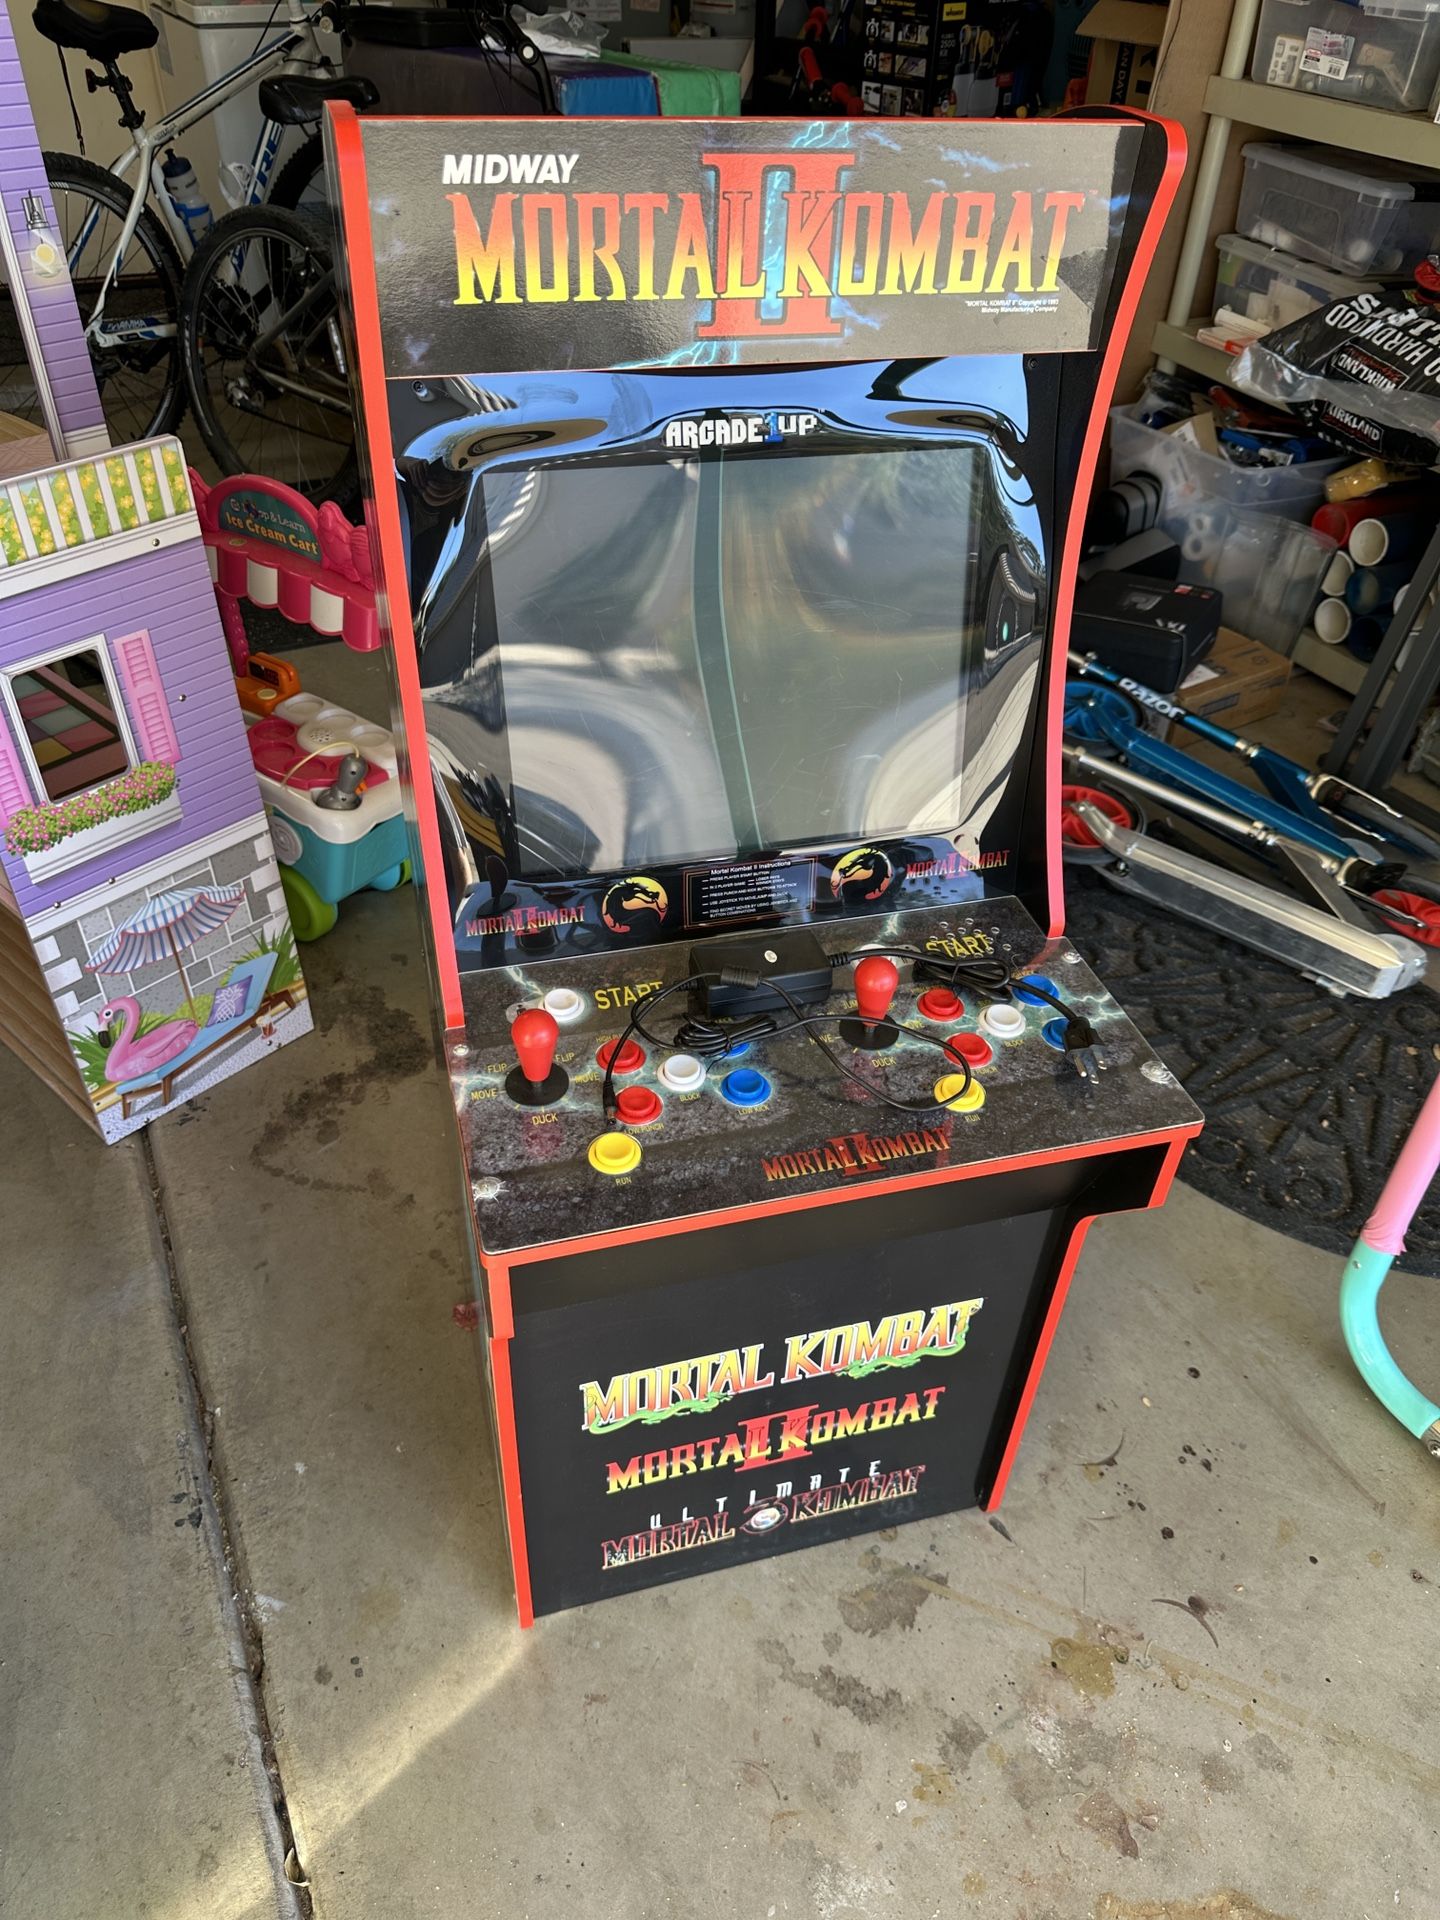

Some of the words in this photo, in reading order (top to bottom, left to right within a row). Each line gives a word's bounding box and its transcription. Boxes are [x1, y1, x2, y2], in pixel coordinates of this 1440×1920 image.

[442, 153, 579, 185] MIDWAY
[445, 190, 767, 305] MORTAL
[777, 190, 1086, 298] KOMBAT
[1327, 403, 1381, 441] KIRKLAND
[277, 512, 306, 534] Learn
[225, 511, 244, 529] Ice
[245, 518, 287, 544] Cream
[288, 533, 319, 556] Cart
[710, 867, 729, 876] Mortal
[730, 864, 752, 874] Kombat
[758, 860, 792, 870] Instructions
[906, 858, 957, 880] MORTAL
[957, 850, 1011, 873] KOMBAT
[465, 911, 525, 937] MORTAL
[526, 905, 586, 930] KOMBAT
[925, 933, 992, 958] START
[1003, 1039, 1025, 1048] BLOCK
[555, 1052, 575, 1062] FLIP
[872, 1056, 897, 1068] DUCK
[487, 1063, 507, 1074] FLIP
[574, 1071, 600, 1084] MOVE
[470, 1088, 498, 1102] MOVE
[680, 1092, 701, 1103] BLOCK
[531, 1113, 558, 1126] DUCK
[737, 1107, 753, 1116] LOW
[754, 1104, 770, 1113] KICK
[965, 1114, 981, 1123] RUN
[641, 1122, 665, 1134] PUNCH
[760, 1146, 858, 1182] MORTAL
[860, 1127, 951, 1165] KOMBAT
[615, 1176, 632, 1187] RUN
[579, 1343, 775, 1431] MORTAL
[781, 1297, 984, 1384] KOMBAT
[605, 1428, 772, 1494] MORTAL
[777, 1386, 946, 1452] KOMBAT
[649, 1459, 882, 1531] ULTIMATE
[601, 1511, 735, 1571] MORTAL
[789, 1465, 926, 1524] KOMBAT
